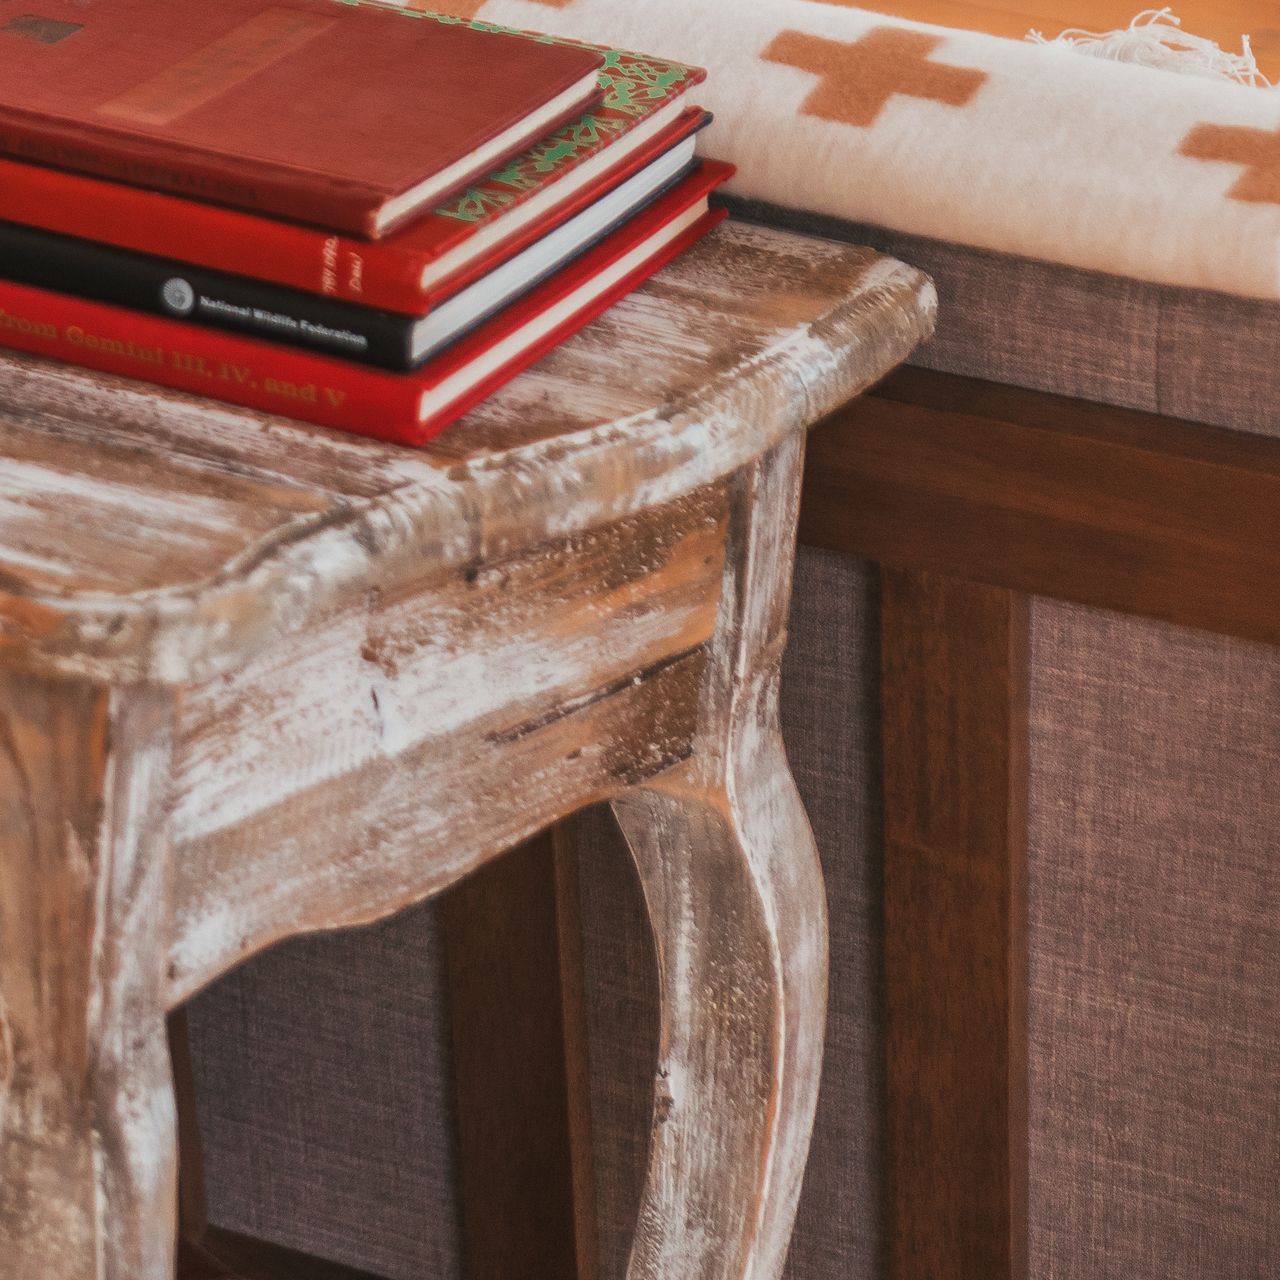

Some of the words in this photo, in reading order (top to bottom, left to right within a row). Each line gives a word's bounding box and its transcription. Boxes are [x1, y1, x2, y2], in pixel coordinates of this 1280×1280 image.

[200, 295, 251, 317] National
[300, 320, 368, 347] Federation
[64, 326, 164, 364] Gemini
[264, 378, 317, 403] and
[326, 388, 348, 408] V
